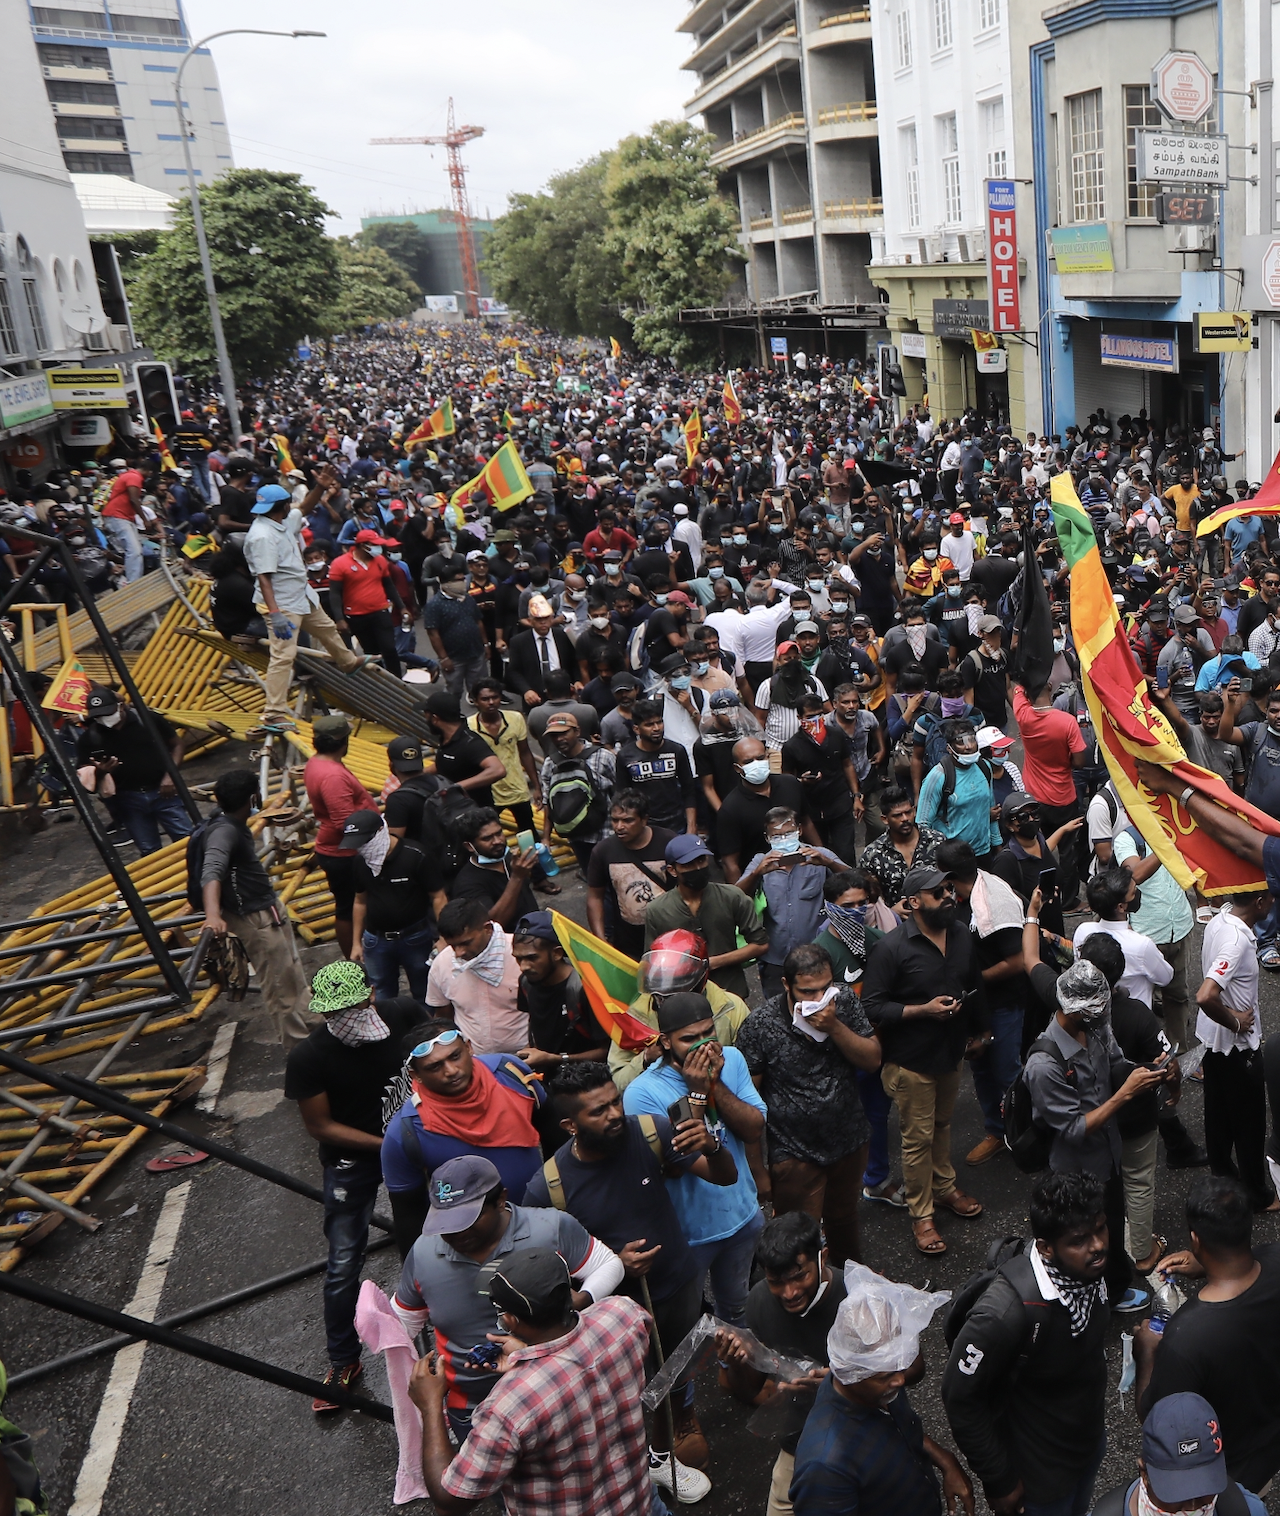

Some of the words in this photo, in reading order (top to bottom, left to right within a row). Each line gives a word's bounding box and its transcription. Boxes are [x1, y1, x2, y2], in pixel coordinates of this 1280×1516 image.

[1153, 150, 1185, 165] சம்பத்
[993, 217, 1015, 330] HOTEL
[1143, 341, 1172, 361] HOTEL
[1215, 961, 1229, 975] 2
[958, 1344, 984, 1375] 3
